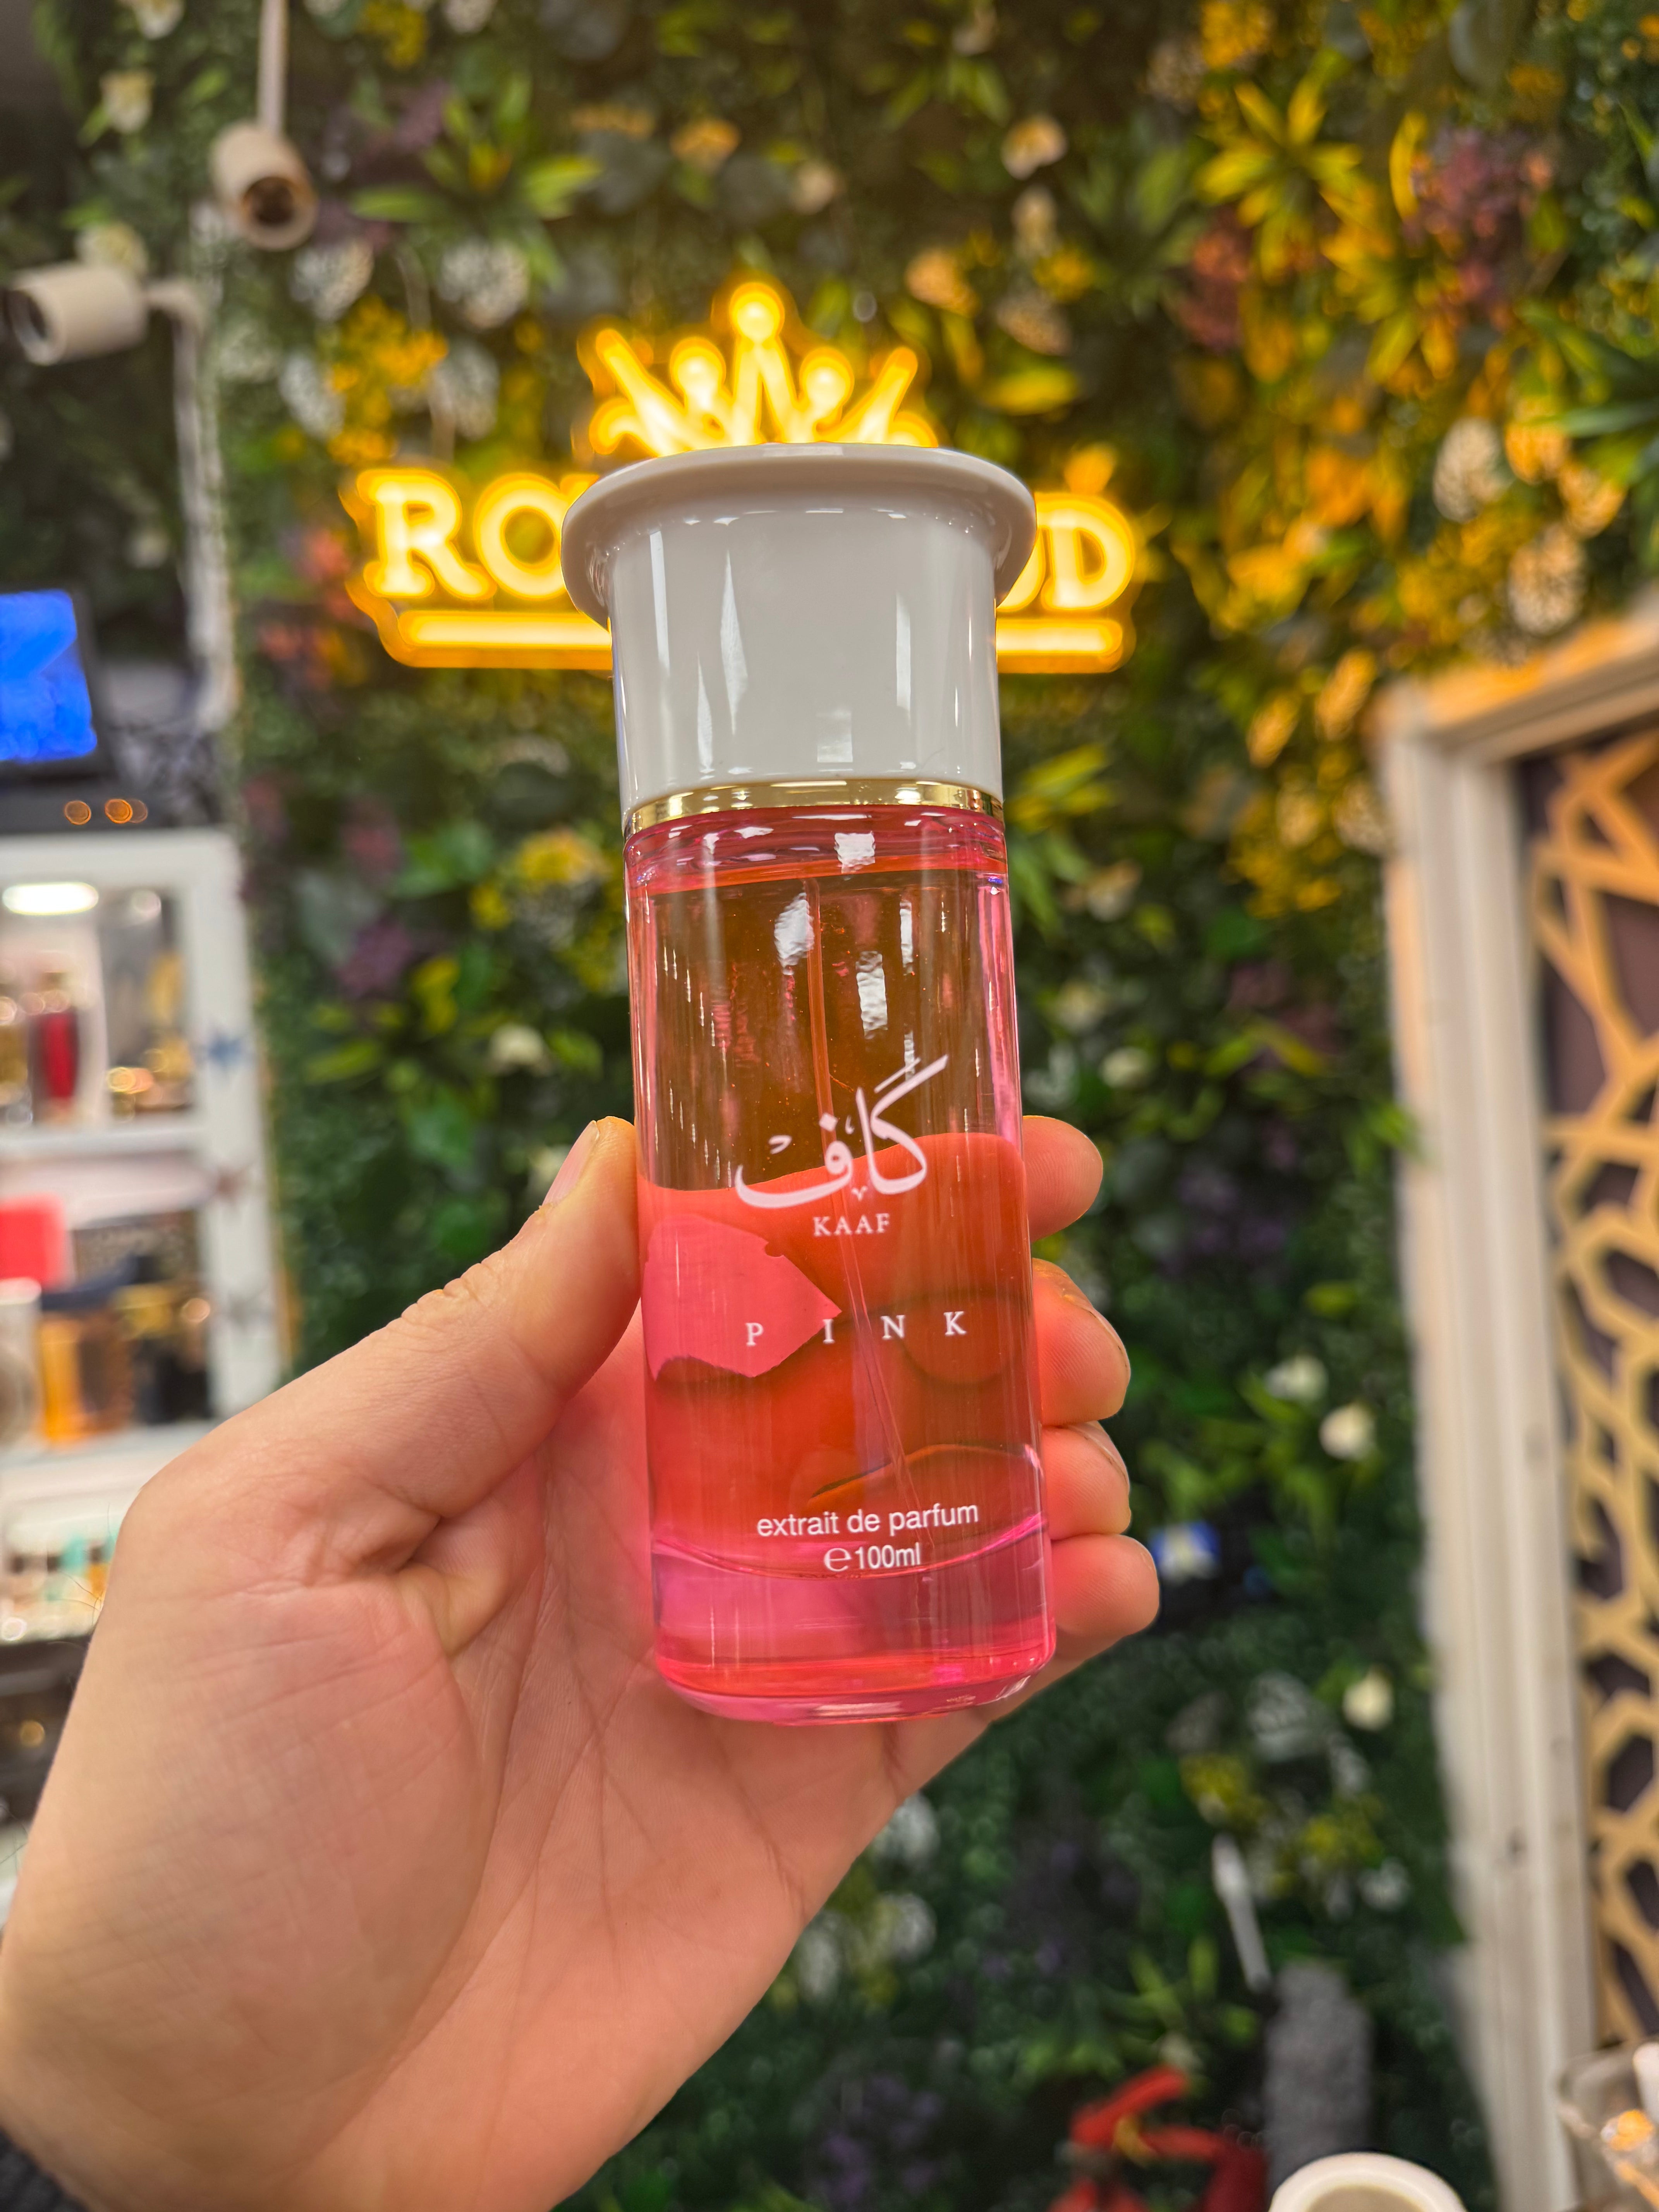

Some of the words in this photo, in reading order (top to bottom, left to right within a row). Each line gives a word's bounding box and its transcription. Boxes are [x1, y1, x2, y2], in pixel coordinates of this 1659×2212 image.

[358, 469, 599, 600] RO
[813, 1212, 890, 1237] KAAF
[757, 1511, 840, 1537] extrait
[847, 1508, 880, 1534] de
[889, 1503, 979, 1537] parfum
